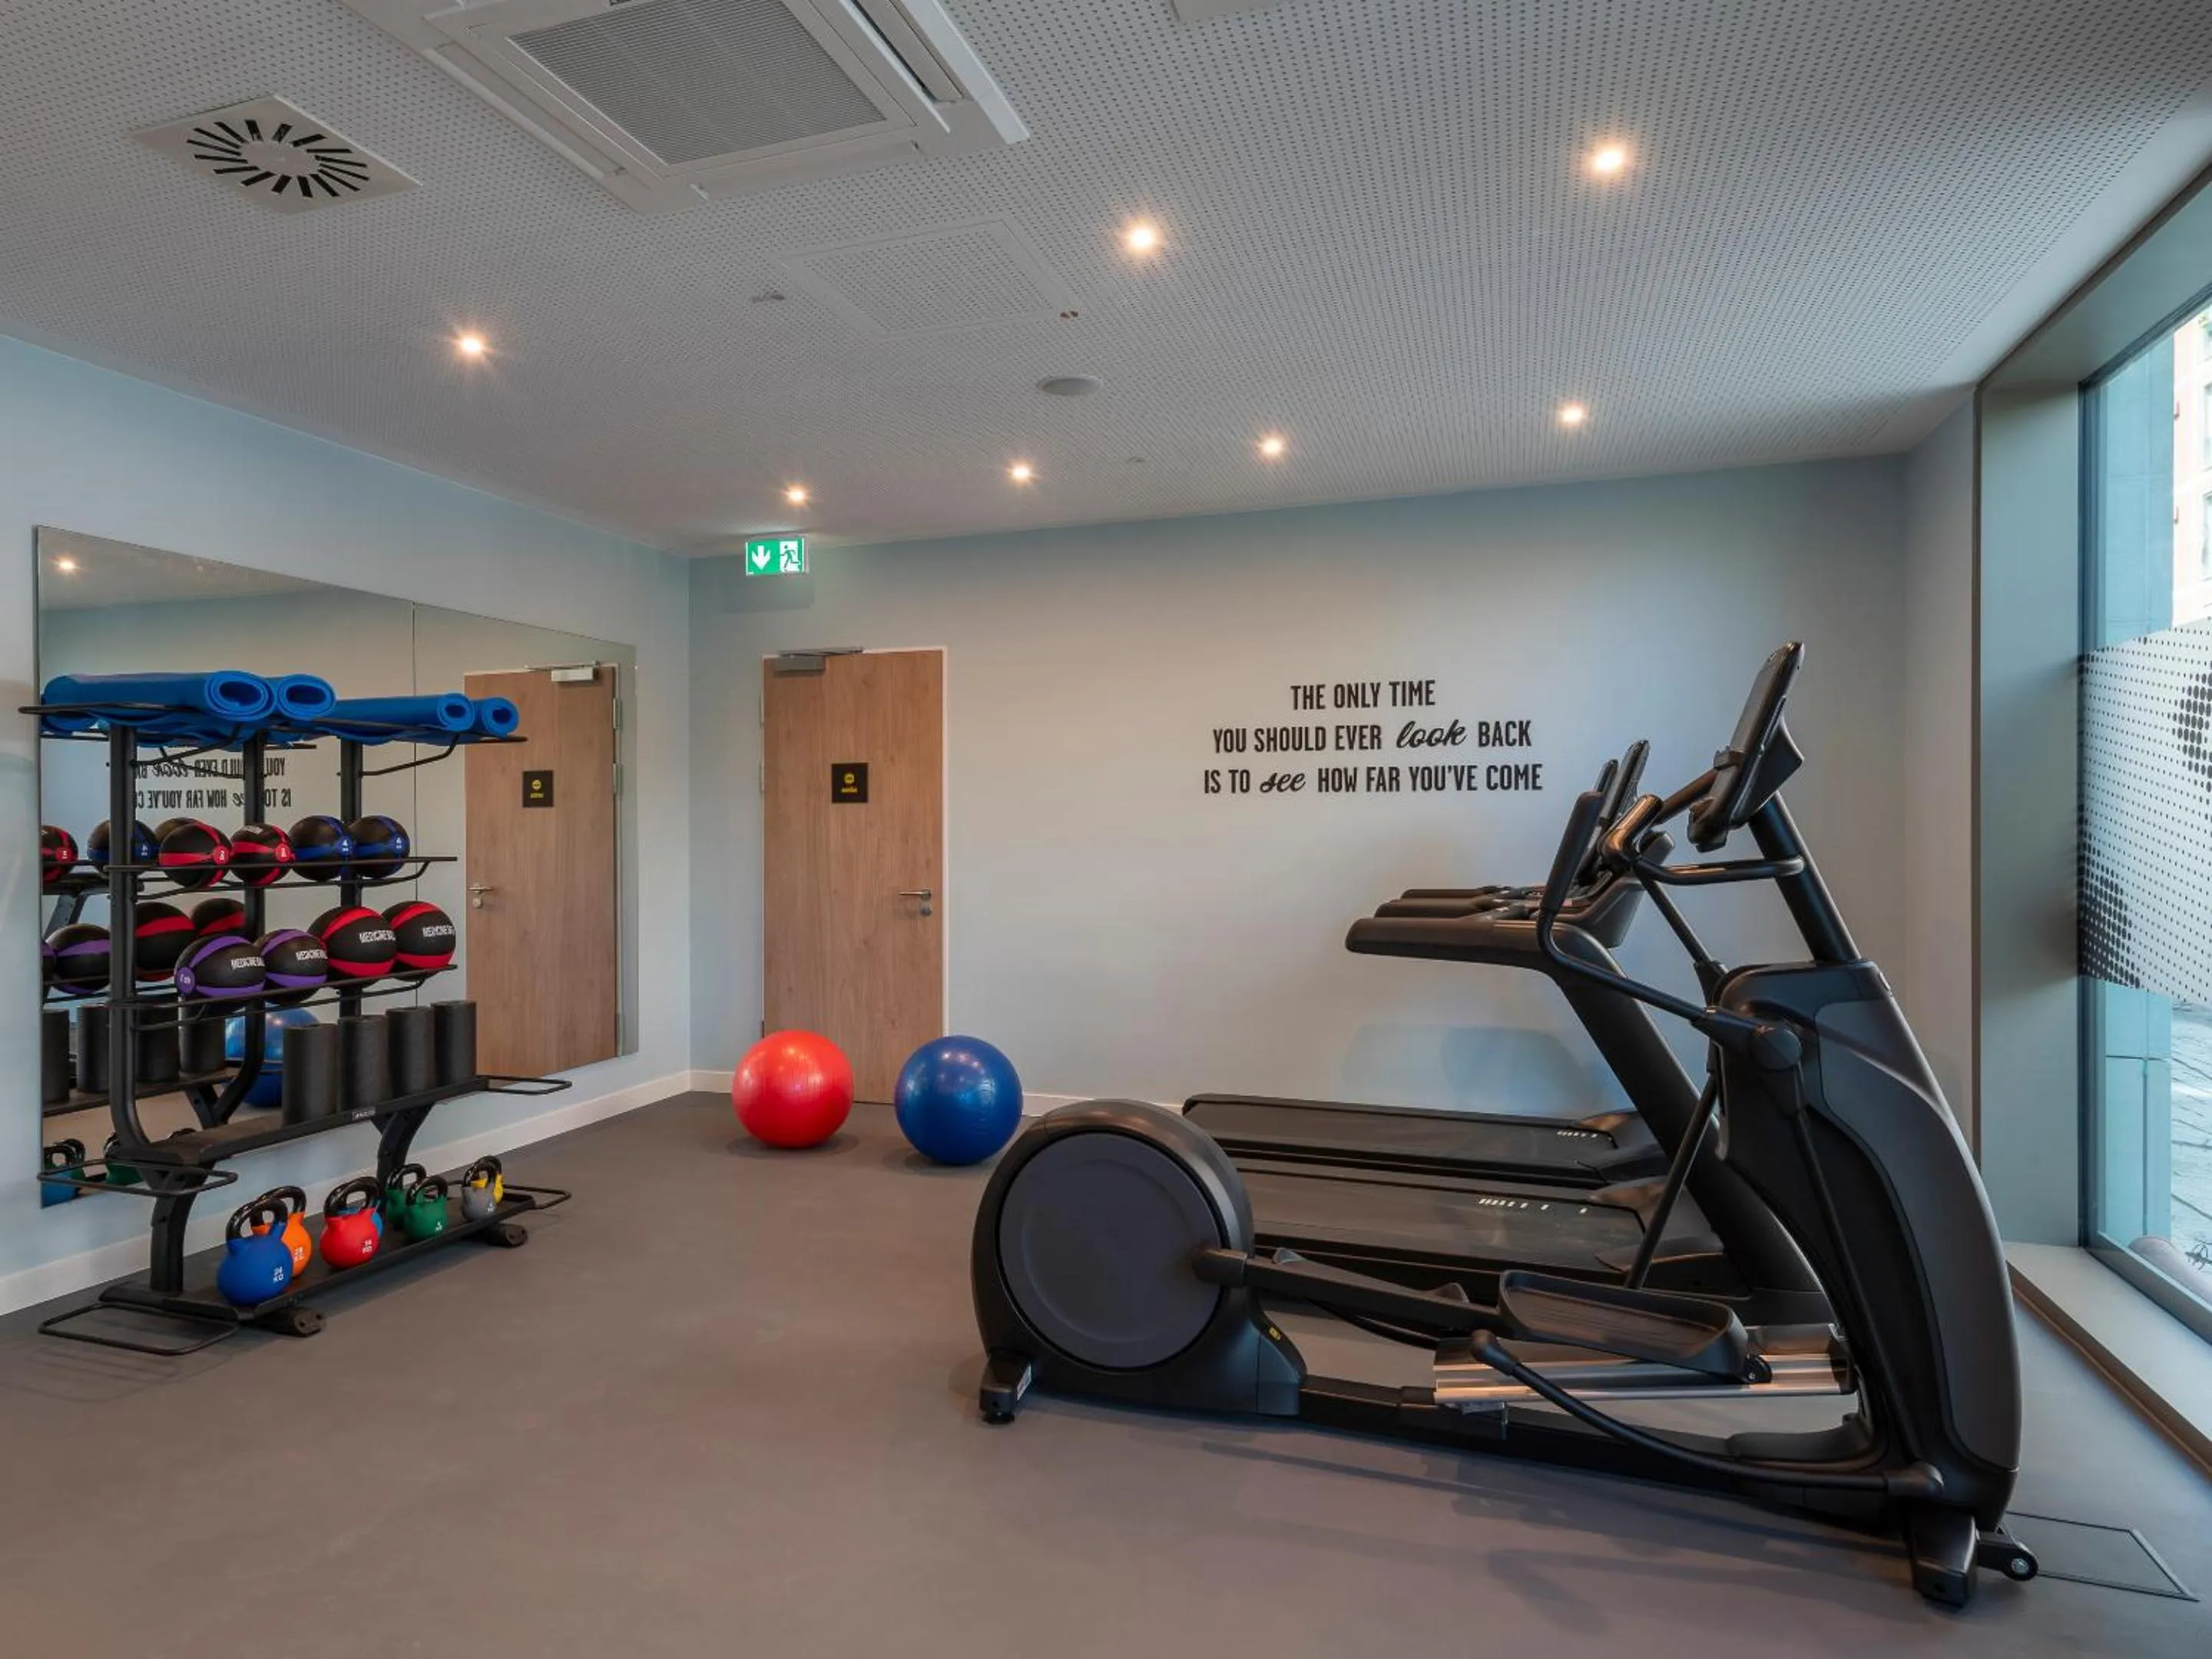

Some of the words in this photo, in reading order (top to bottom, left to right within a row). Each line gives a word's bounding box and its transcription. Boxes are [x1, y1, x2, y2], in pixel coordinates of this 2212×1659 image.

[1290, 684, 1326, 710] THE
[1333, 681, 1382, 709] ONLY
[1388, 680, 1436, 707] TIME
[1212, 727, 1247, 754] YOU
[1253, 726, 1326, 753] SHOULD
[1334, 724, 1382, 751] EVER
[1396, 718, 1468, 749] look
[1477, 720, 1532, 749] BACK
[1204, 769, 1222, 794] IS
[1227, 769, 1251, 794] TO
[1259, 772, 1306, 794] see
[1317, 767, 1359, 793] HOW
[1366, 766, 1401, 793] FAR
[1408, 764, 1479, 793] YOU'VE
[1485, 763, 1543, 791] COME
